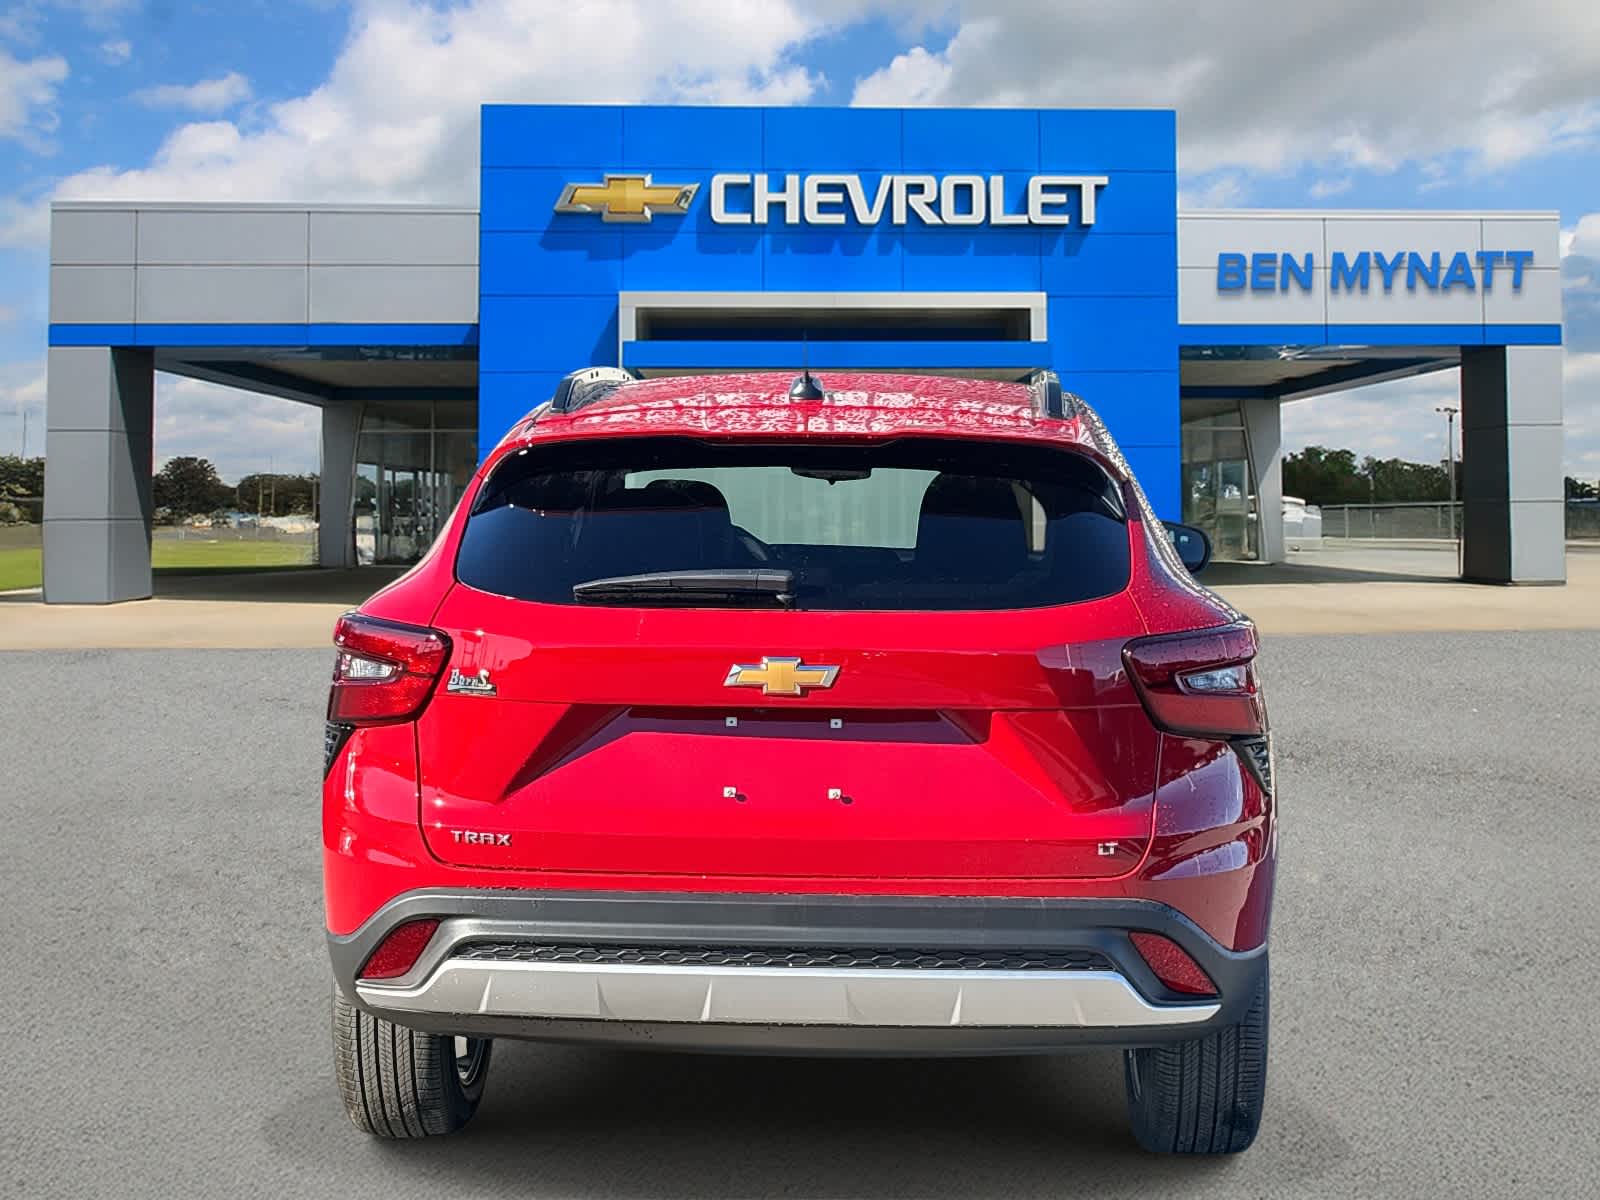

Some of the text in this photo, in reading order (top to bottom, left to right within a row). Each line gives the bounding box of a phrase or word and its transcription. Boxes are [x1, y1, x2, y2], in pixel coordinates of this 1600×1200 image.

[710, 174, 1109, 225] CHEVROLET
[1217, 250, 1534, 291] BEN MYNATT
[450, 829, 511, 846] TRAX
[1097, 842, 1118, 856] LT
